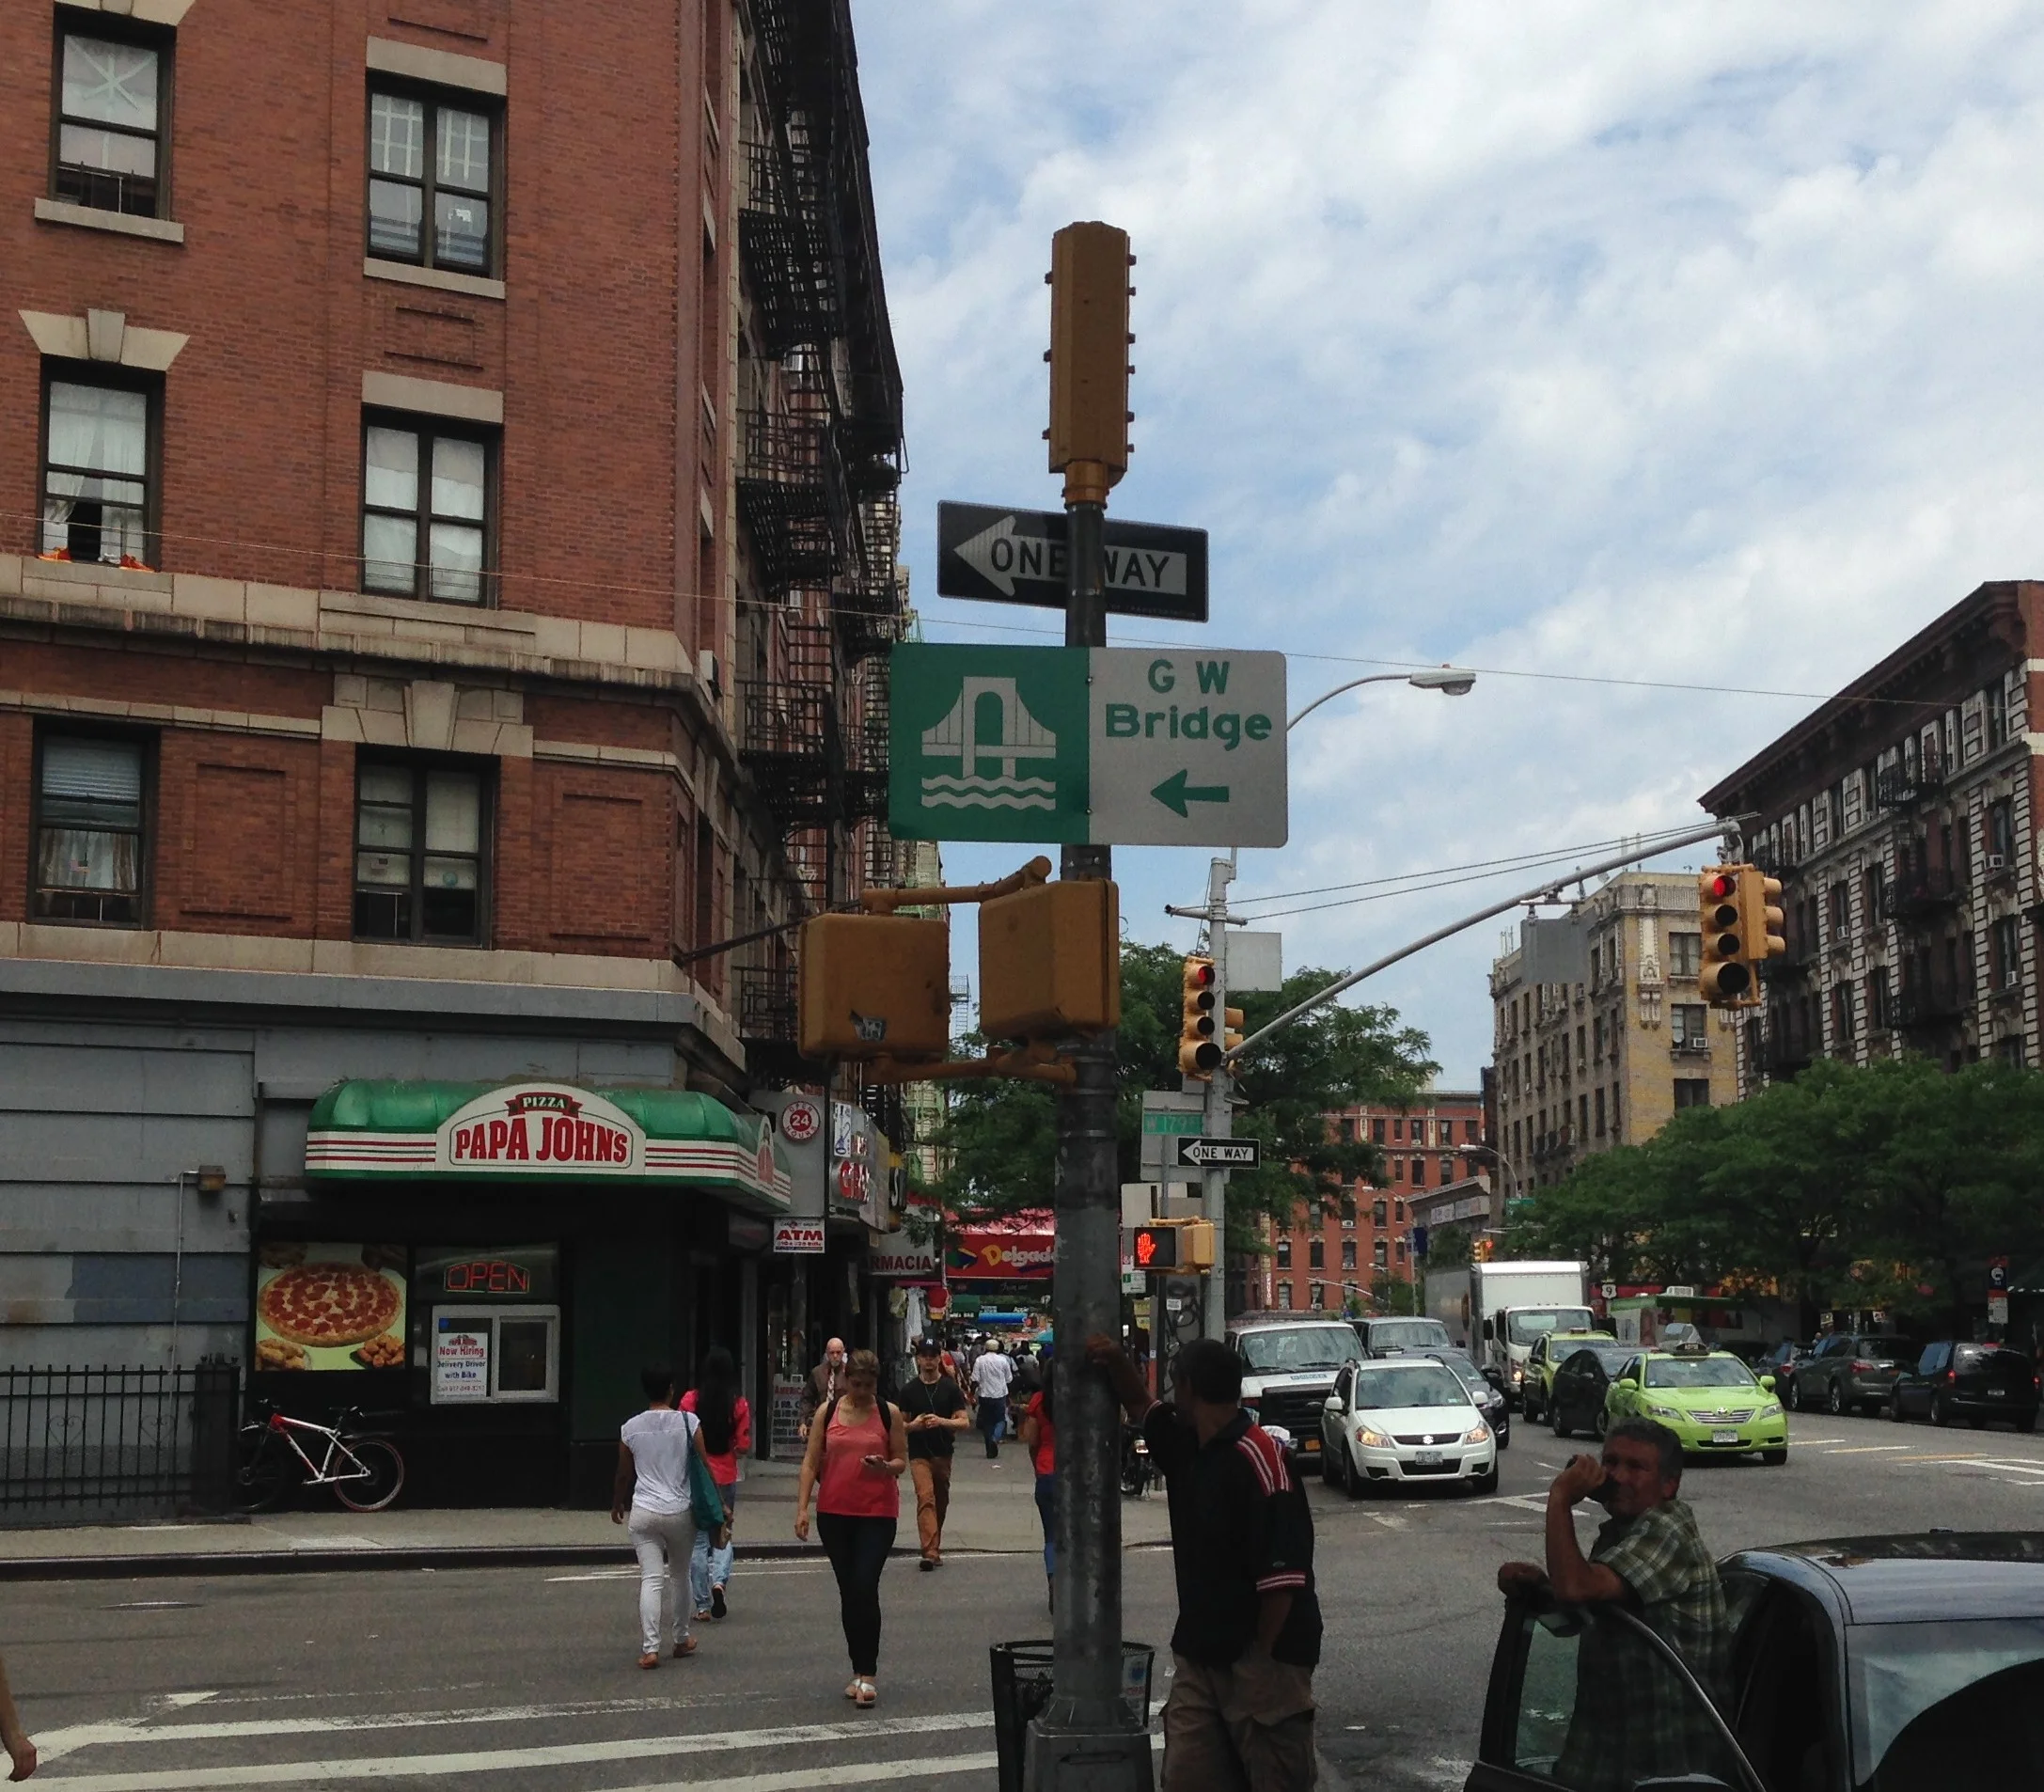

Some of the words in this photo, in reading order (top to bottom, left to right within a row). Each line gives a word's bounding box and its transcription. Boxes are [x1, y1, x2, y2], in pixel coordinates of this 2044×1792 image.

[991, 538, 1066, 576] ONE
[1147, 659, 1175, 694] G
[1196, 661, 1231, 695] W
[1105, 703, 1272, 752] Bridge
[522, 1096, 565, 1108] PIZZA
[792, 1114, 810, 1126] 24
[455, 1118, 529, 1160] PAPA
[536, 1117, 628, 1163] JOHN'S
[1192, 1147, 1218, 1158] ONE
[1224, 1148, 1249, 1159] WAY
[777, 1229, 824, 1241] ATM
[981, 1244, 1054, 1267] Delgad
[447, 1262, 527, 1291] OPEN
[439, 1346, 457, 1355] Now
[460, 1346, 484, 1357] Hiring
